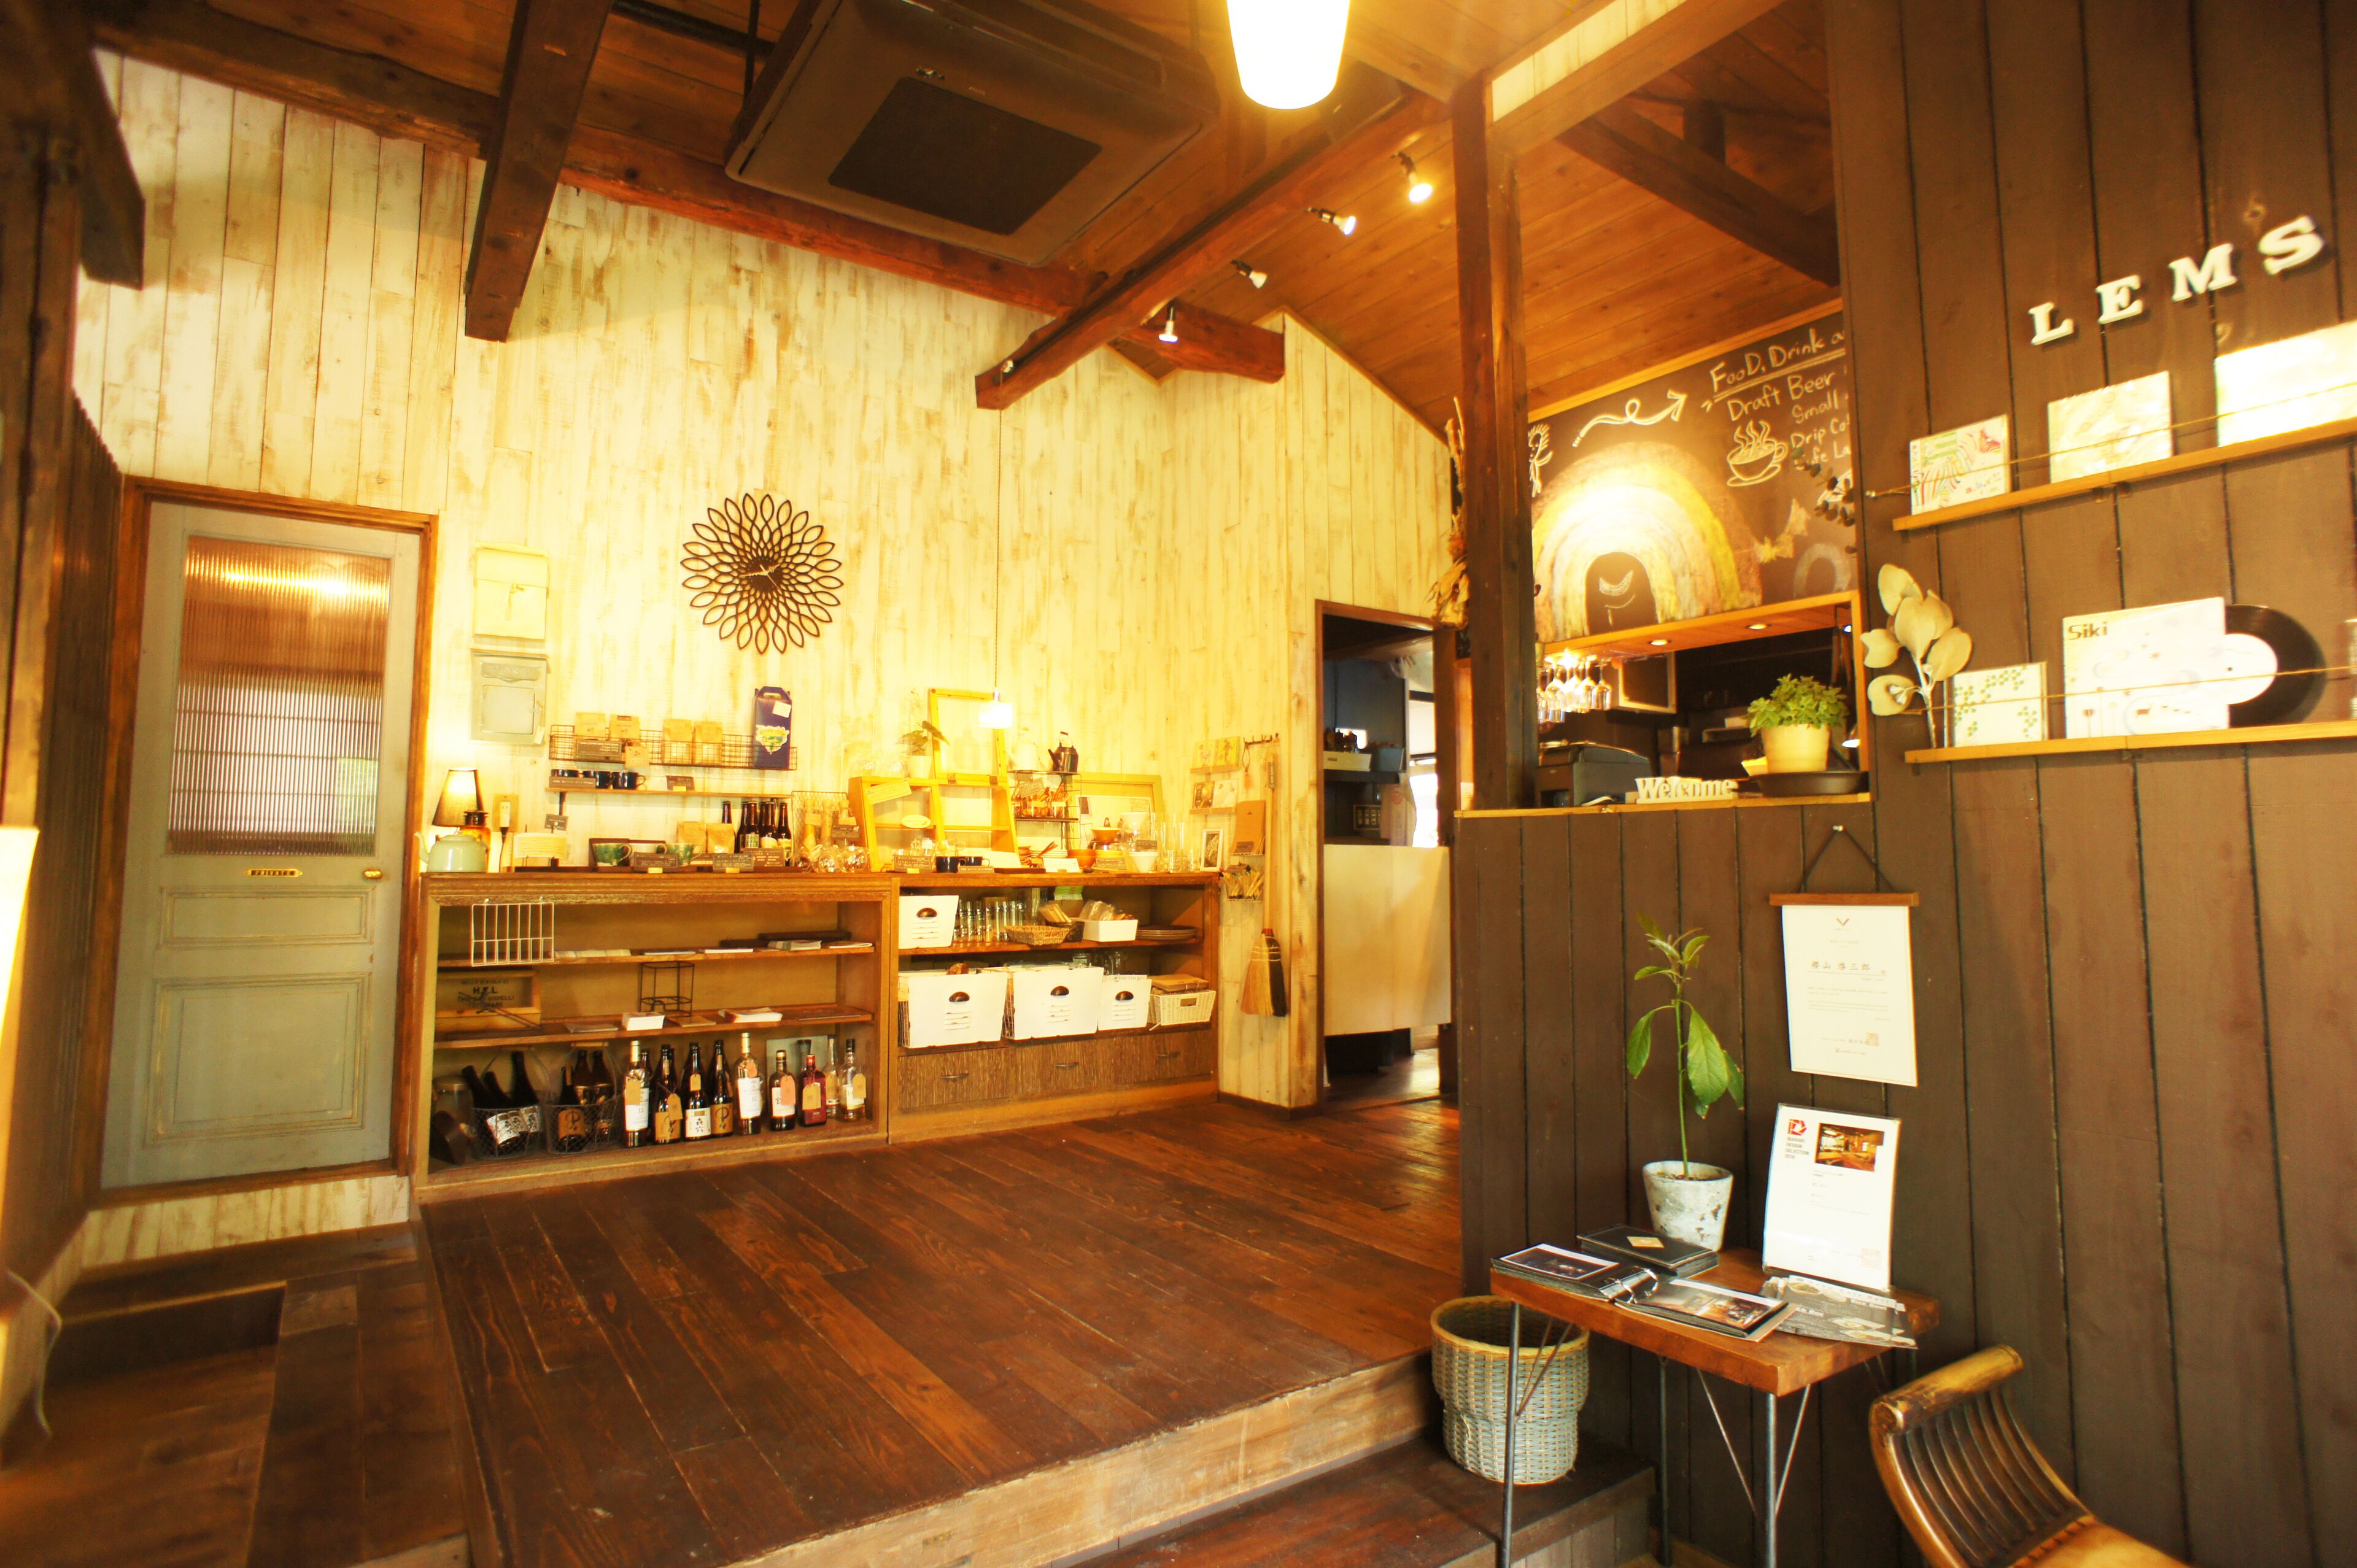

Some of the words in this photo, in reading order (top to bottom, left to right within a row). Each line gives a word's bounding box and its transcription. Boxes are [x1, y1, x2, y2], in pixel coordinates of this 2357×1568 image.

[2029, 215, 2324, 346] LEMS
[1768, 328, 1825, 368] Drink
[1727, 384, 1780, 422] Draft
[1787, 372, 1835, 400] Beer
[1792, 389, 1839, 424] Small
[1790, 428, 1825, 448] Drip
[1833, 441, 1851, 459] La
[2067, 621, 2108, 641] Siki
[1635, 776, 1739, 799] Welcome
